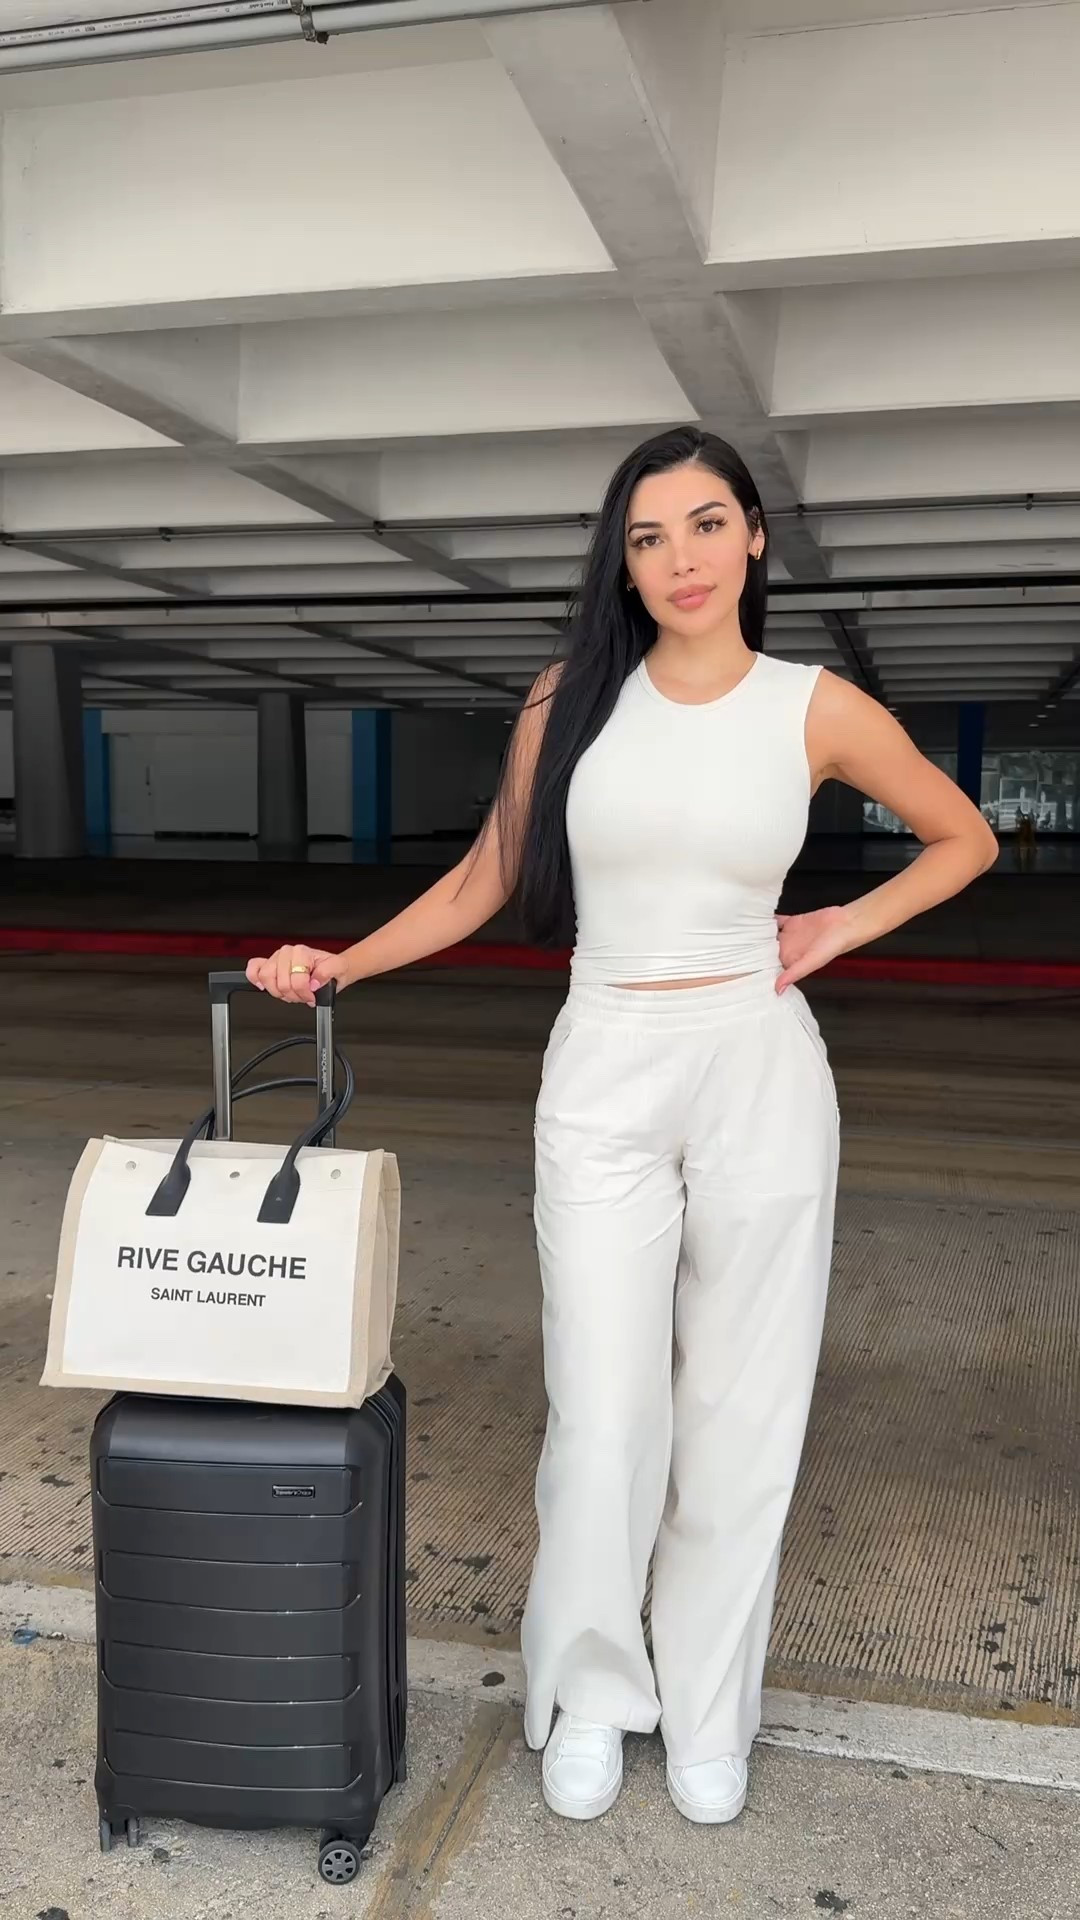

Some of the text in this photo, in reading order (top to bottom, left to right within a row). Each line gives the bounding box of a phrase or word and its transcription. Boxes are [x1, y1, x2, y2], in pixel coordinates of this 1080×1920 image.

[117, 1246, 307, 1280] RIVE GAUCHE
[150, 1287, 267, 1308] SAINT LAURENT
